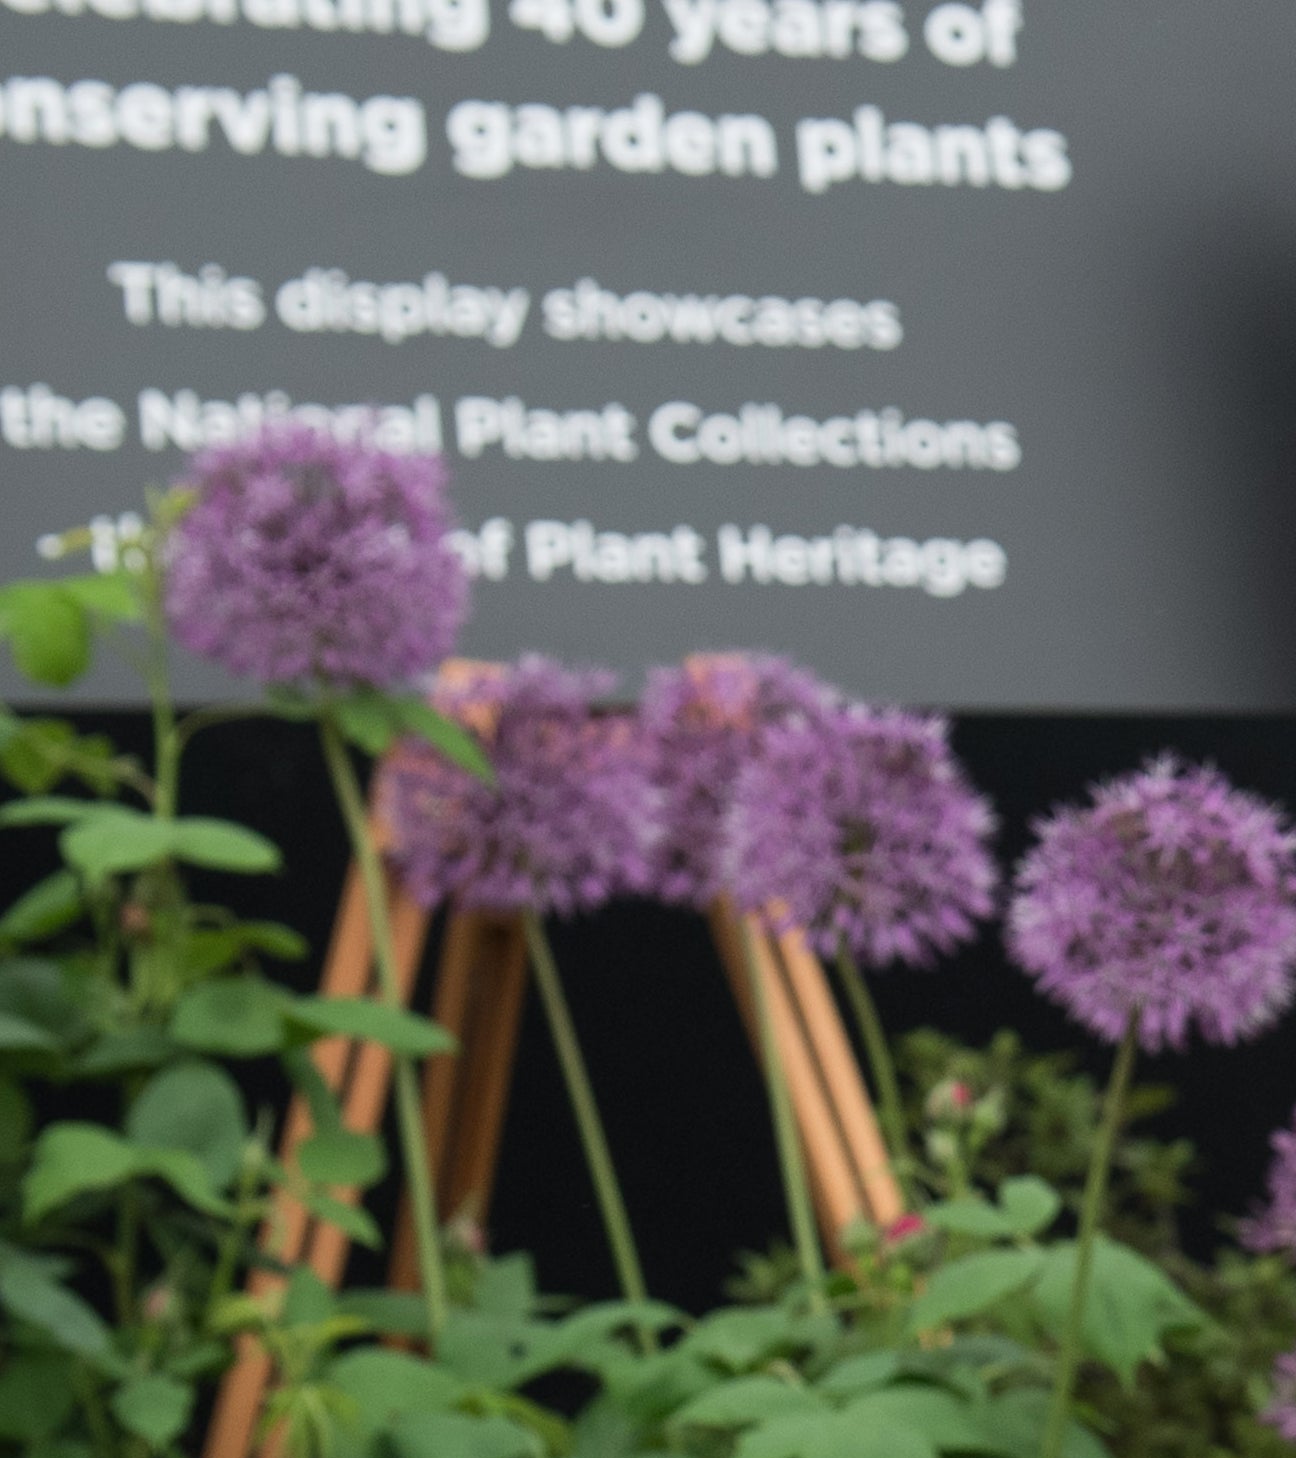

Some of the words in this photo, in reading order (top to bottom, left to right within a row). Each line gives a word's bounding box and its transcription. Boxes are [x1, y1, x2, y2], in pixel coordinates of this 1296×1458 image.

[664, 0, 908, 64] years
[924, 0, 1022, 66] of
[0, 75, 427, 175] nserving
[446, 94, 777, 179] garden
[796, 105, 1071, 193] plants
[108, 262, 265, 329] This
[276, 269, 529, 347] display
[543, 279, 902, 350] showcases
[1, 385, 125, 451] the
[455, 396, 636, 462] Plant
[648, 402, 1021, 471] Collections
[525, 521, 705, 584] Plant
[718, 525, 1006, 597] Heritage
